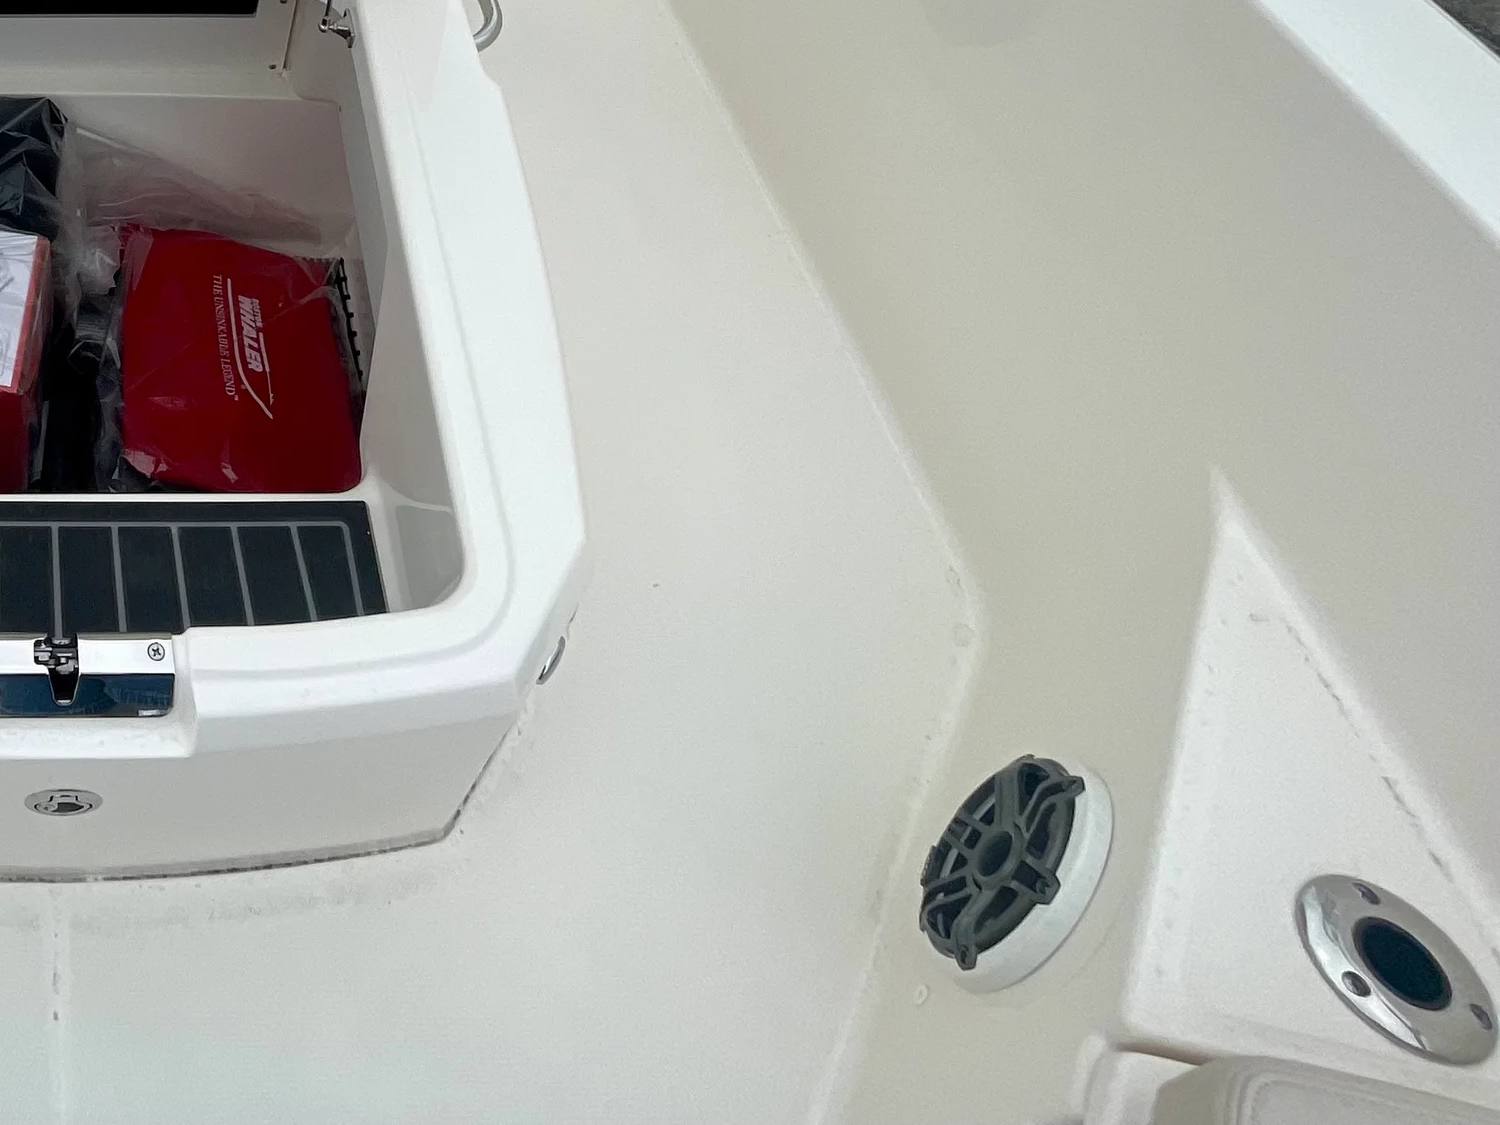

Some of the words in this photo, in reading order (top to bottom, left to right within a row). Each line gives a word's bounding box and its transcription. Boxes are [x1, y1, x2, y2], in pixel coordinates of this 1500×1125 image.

[213, 275, 222, 295] THE
[214, 297, 229, 356] UNSINKABLE
[238, 295, 263, 372] WHALER
